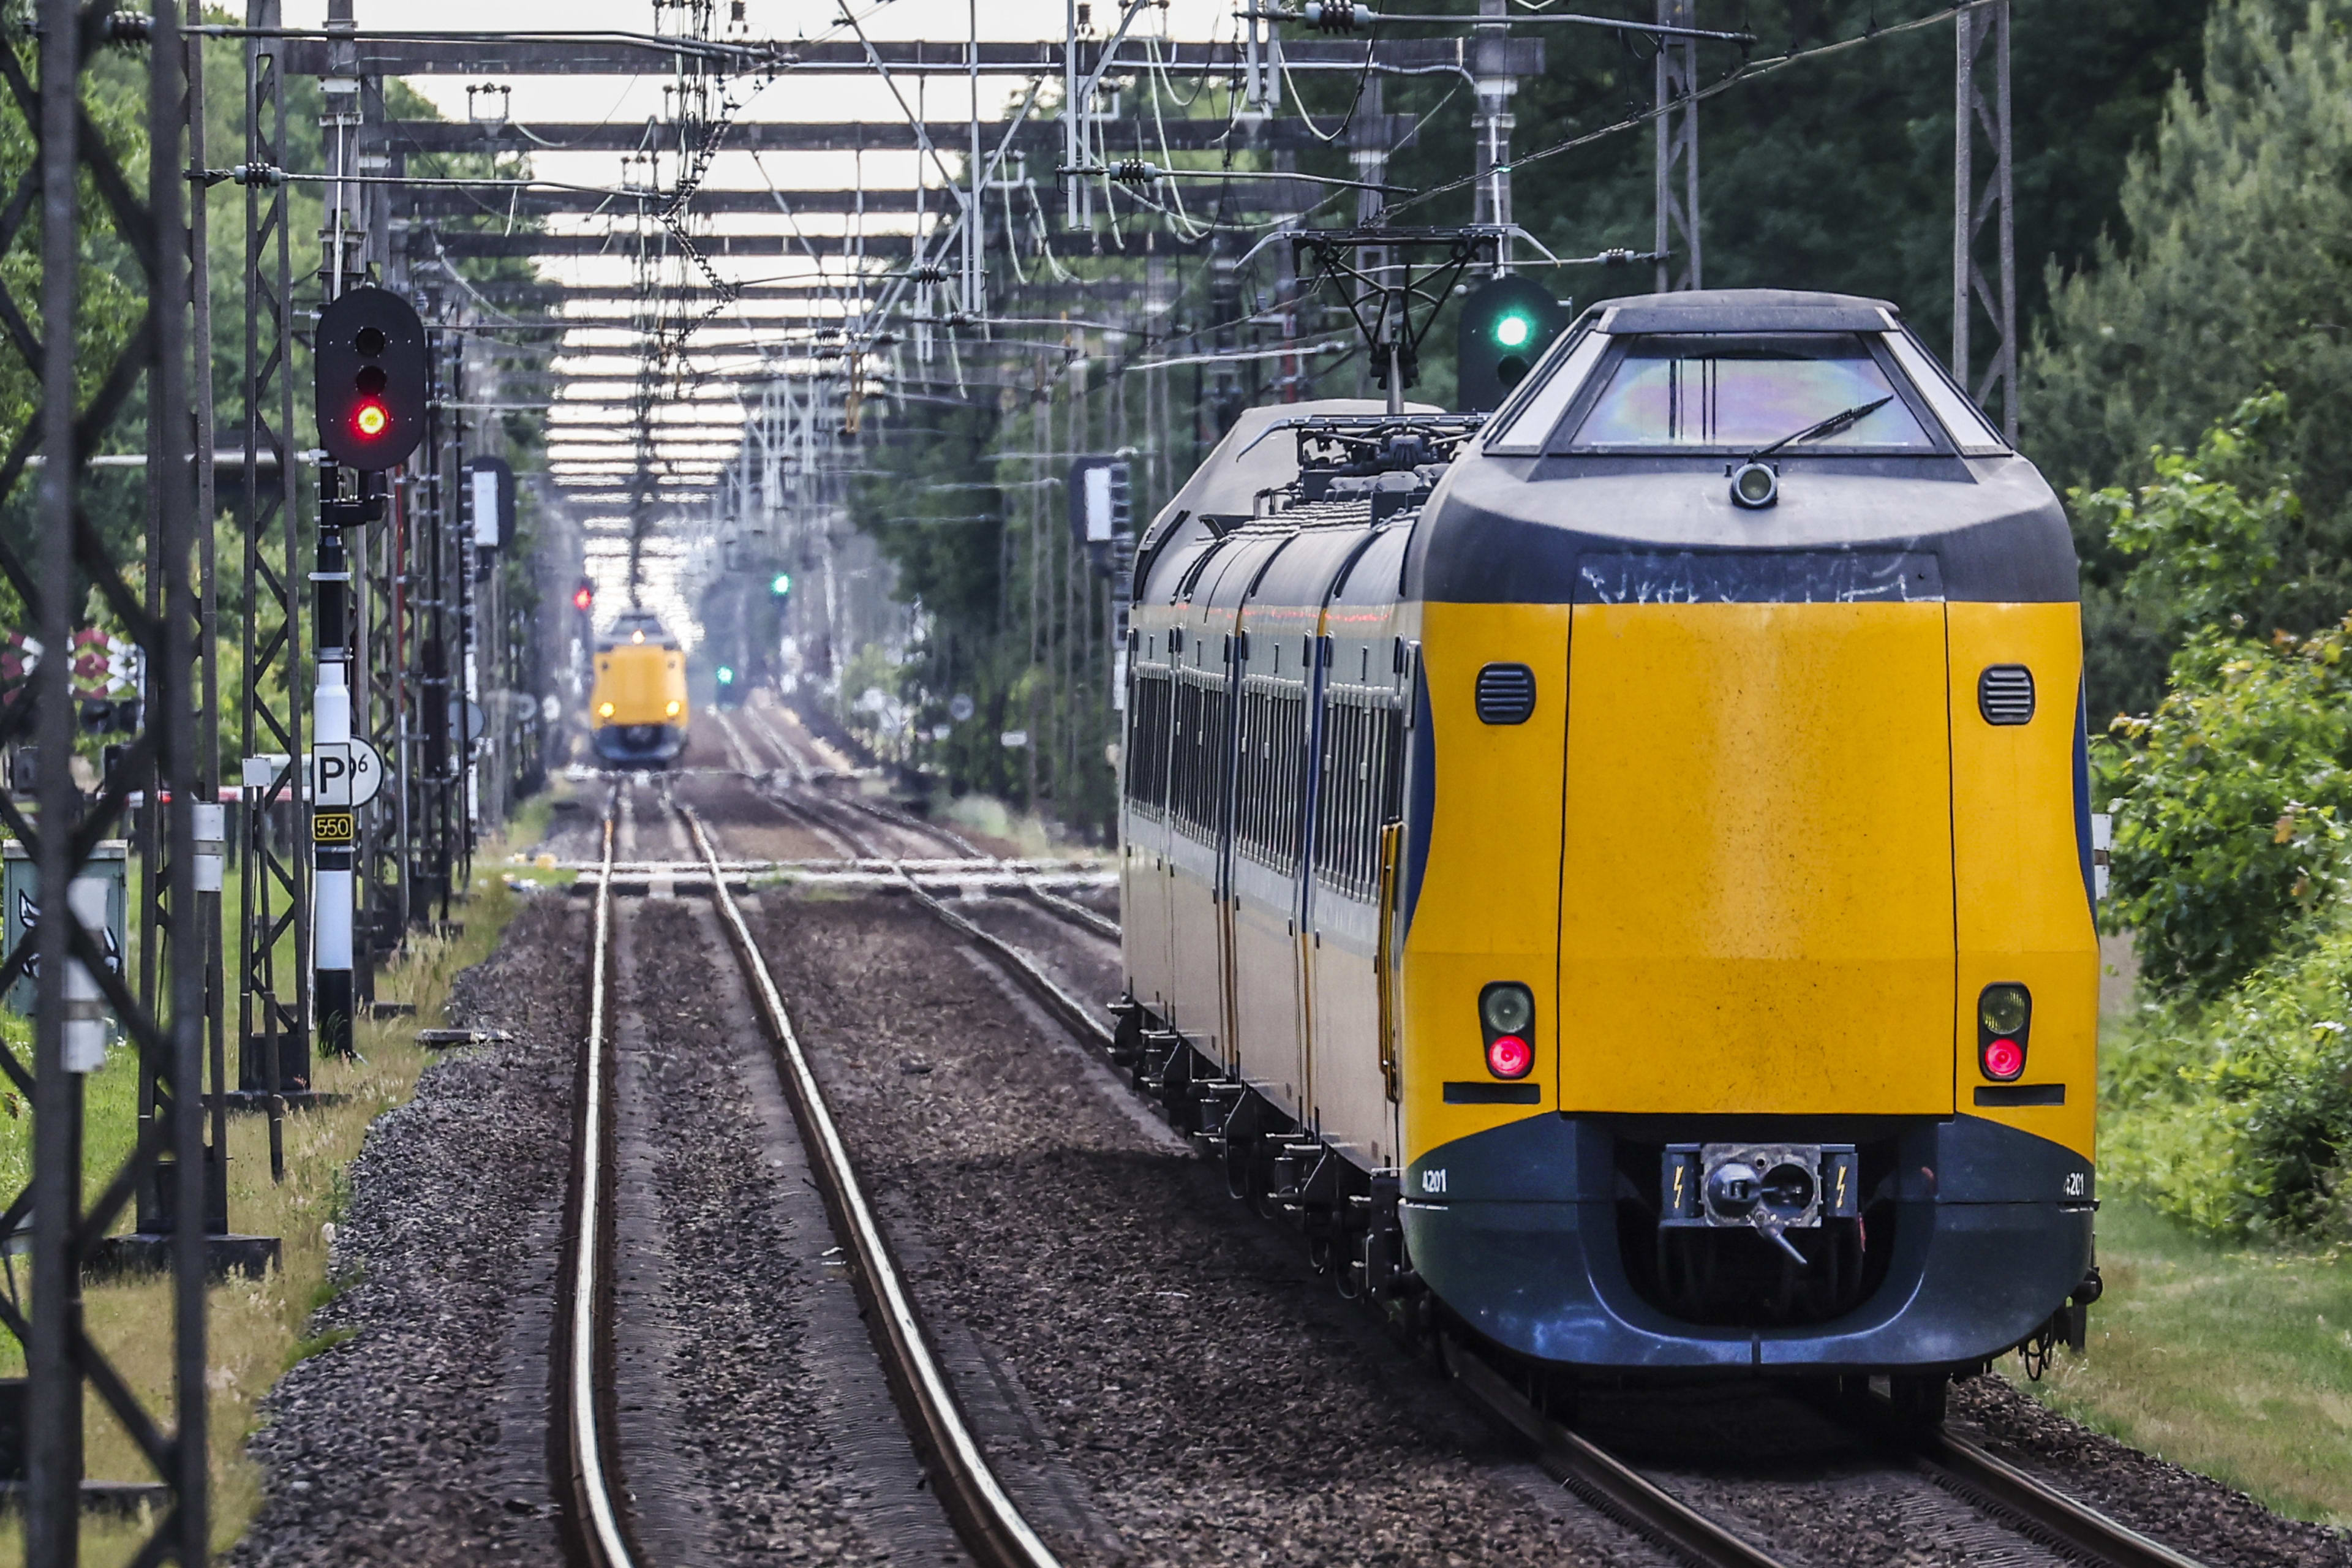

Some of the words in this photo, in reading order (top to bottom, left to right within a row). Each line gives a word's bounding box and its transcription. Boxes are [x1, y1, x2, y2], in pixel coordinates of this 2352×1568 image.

[320, 756, 345, 794] P
[350, 753, 368, 782] 6
[317, 818, 349, 836] 550
[1422, 1168, 1447, 1193] 4201
